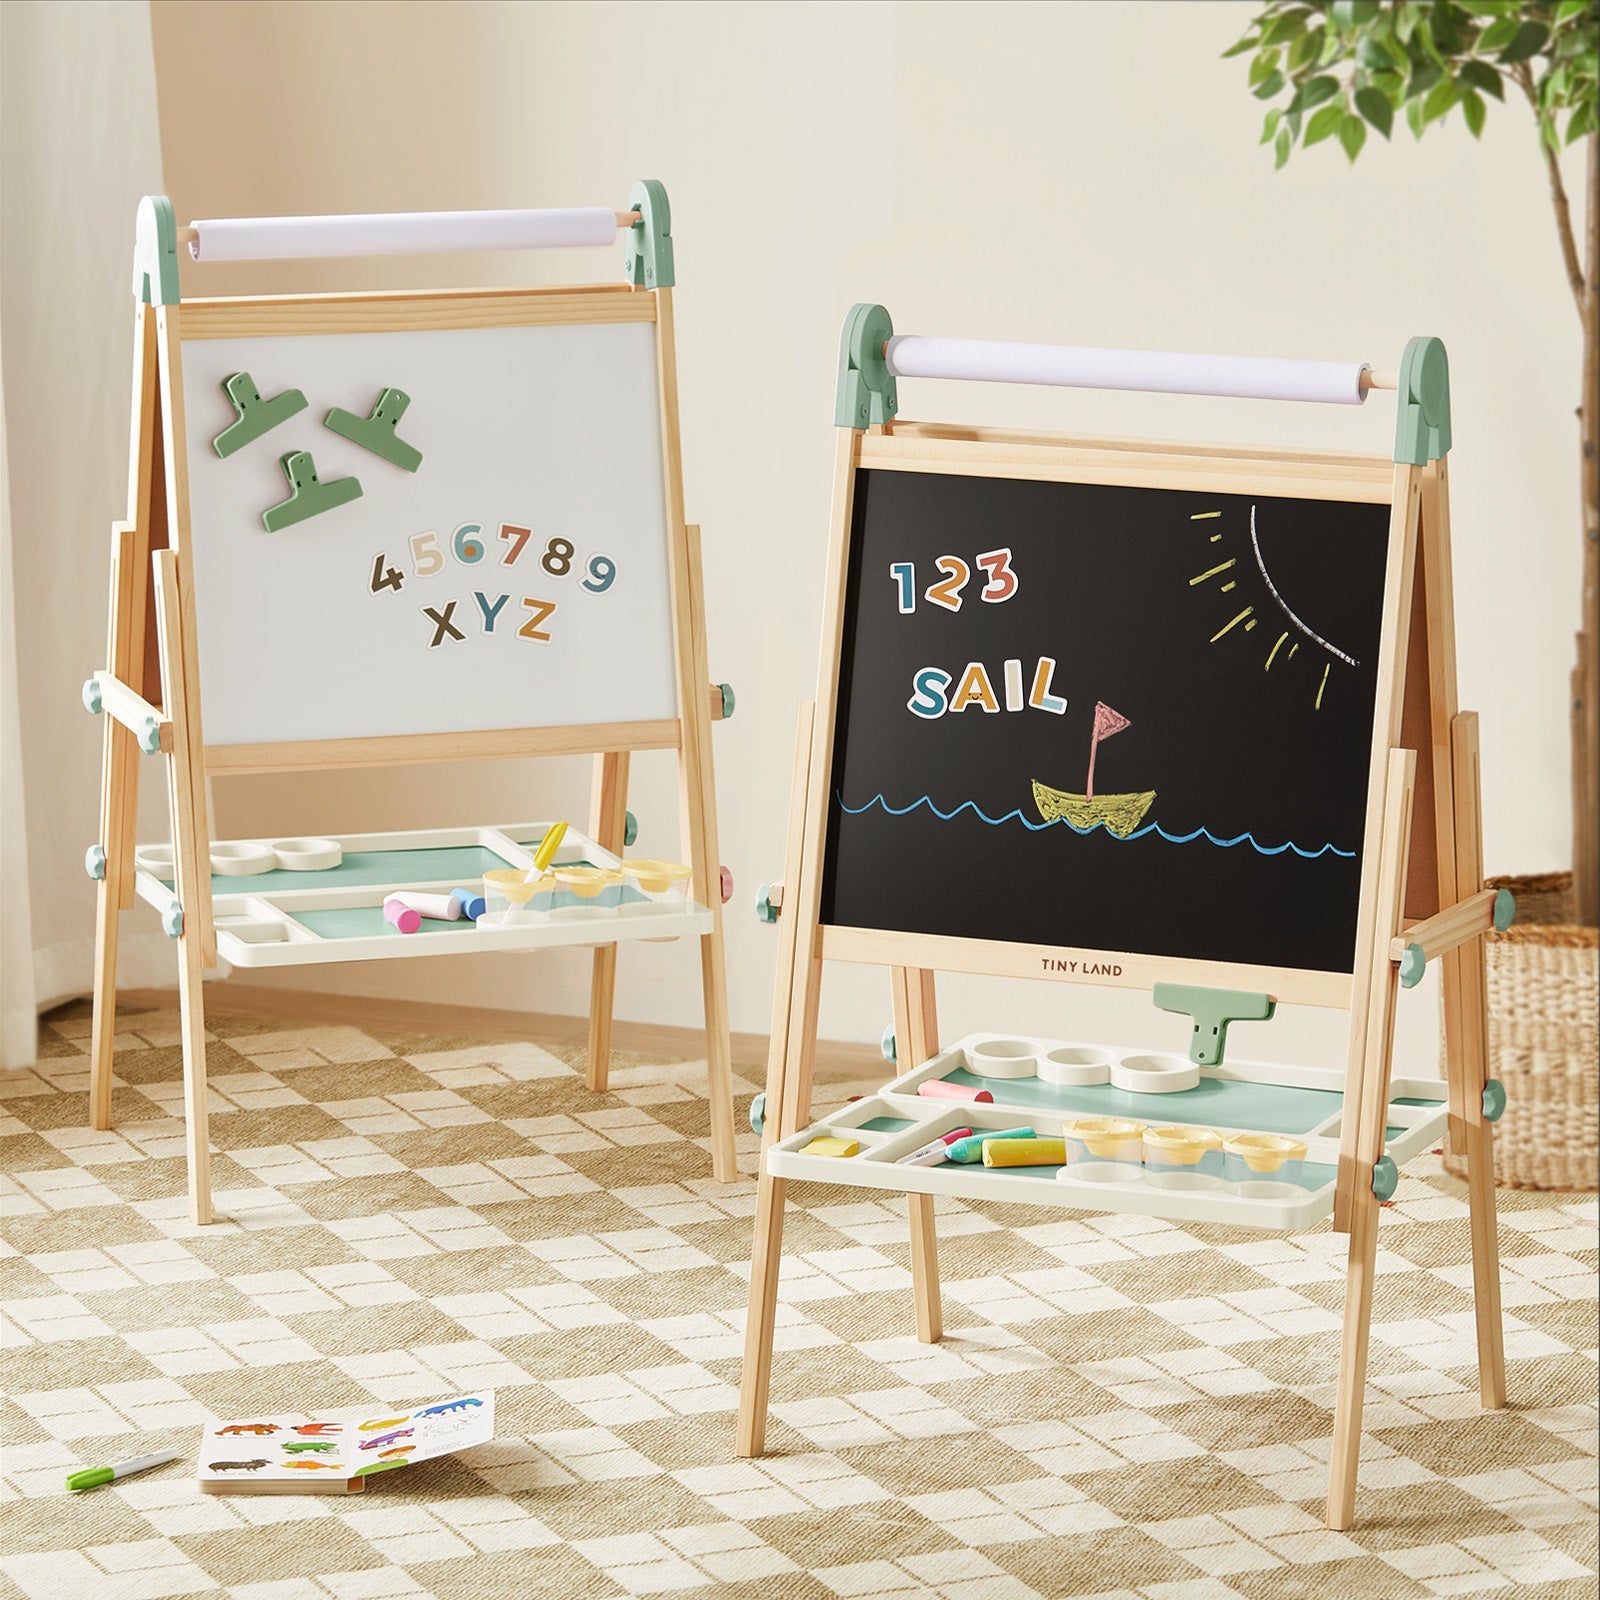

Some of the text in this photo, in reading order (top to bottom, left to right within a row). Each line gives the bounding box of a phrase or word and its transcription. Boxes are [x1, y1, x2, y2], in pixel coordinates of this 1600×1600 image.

[889, 547, 1019, 615] 123
[421, 589, 556, 650] XYZ
[906, 656, 1068, 720] SAIL
[1042, 958, 1123, 977] TINY LAND
